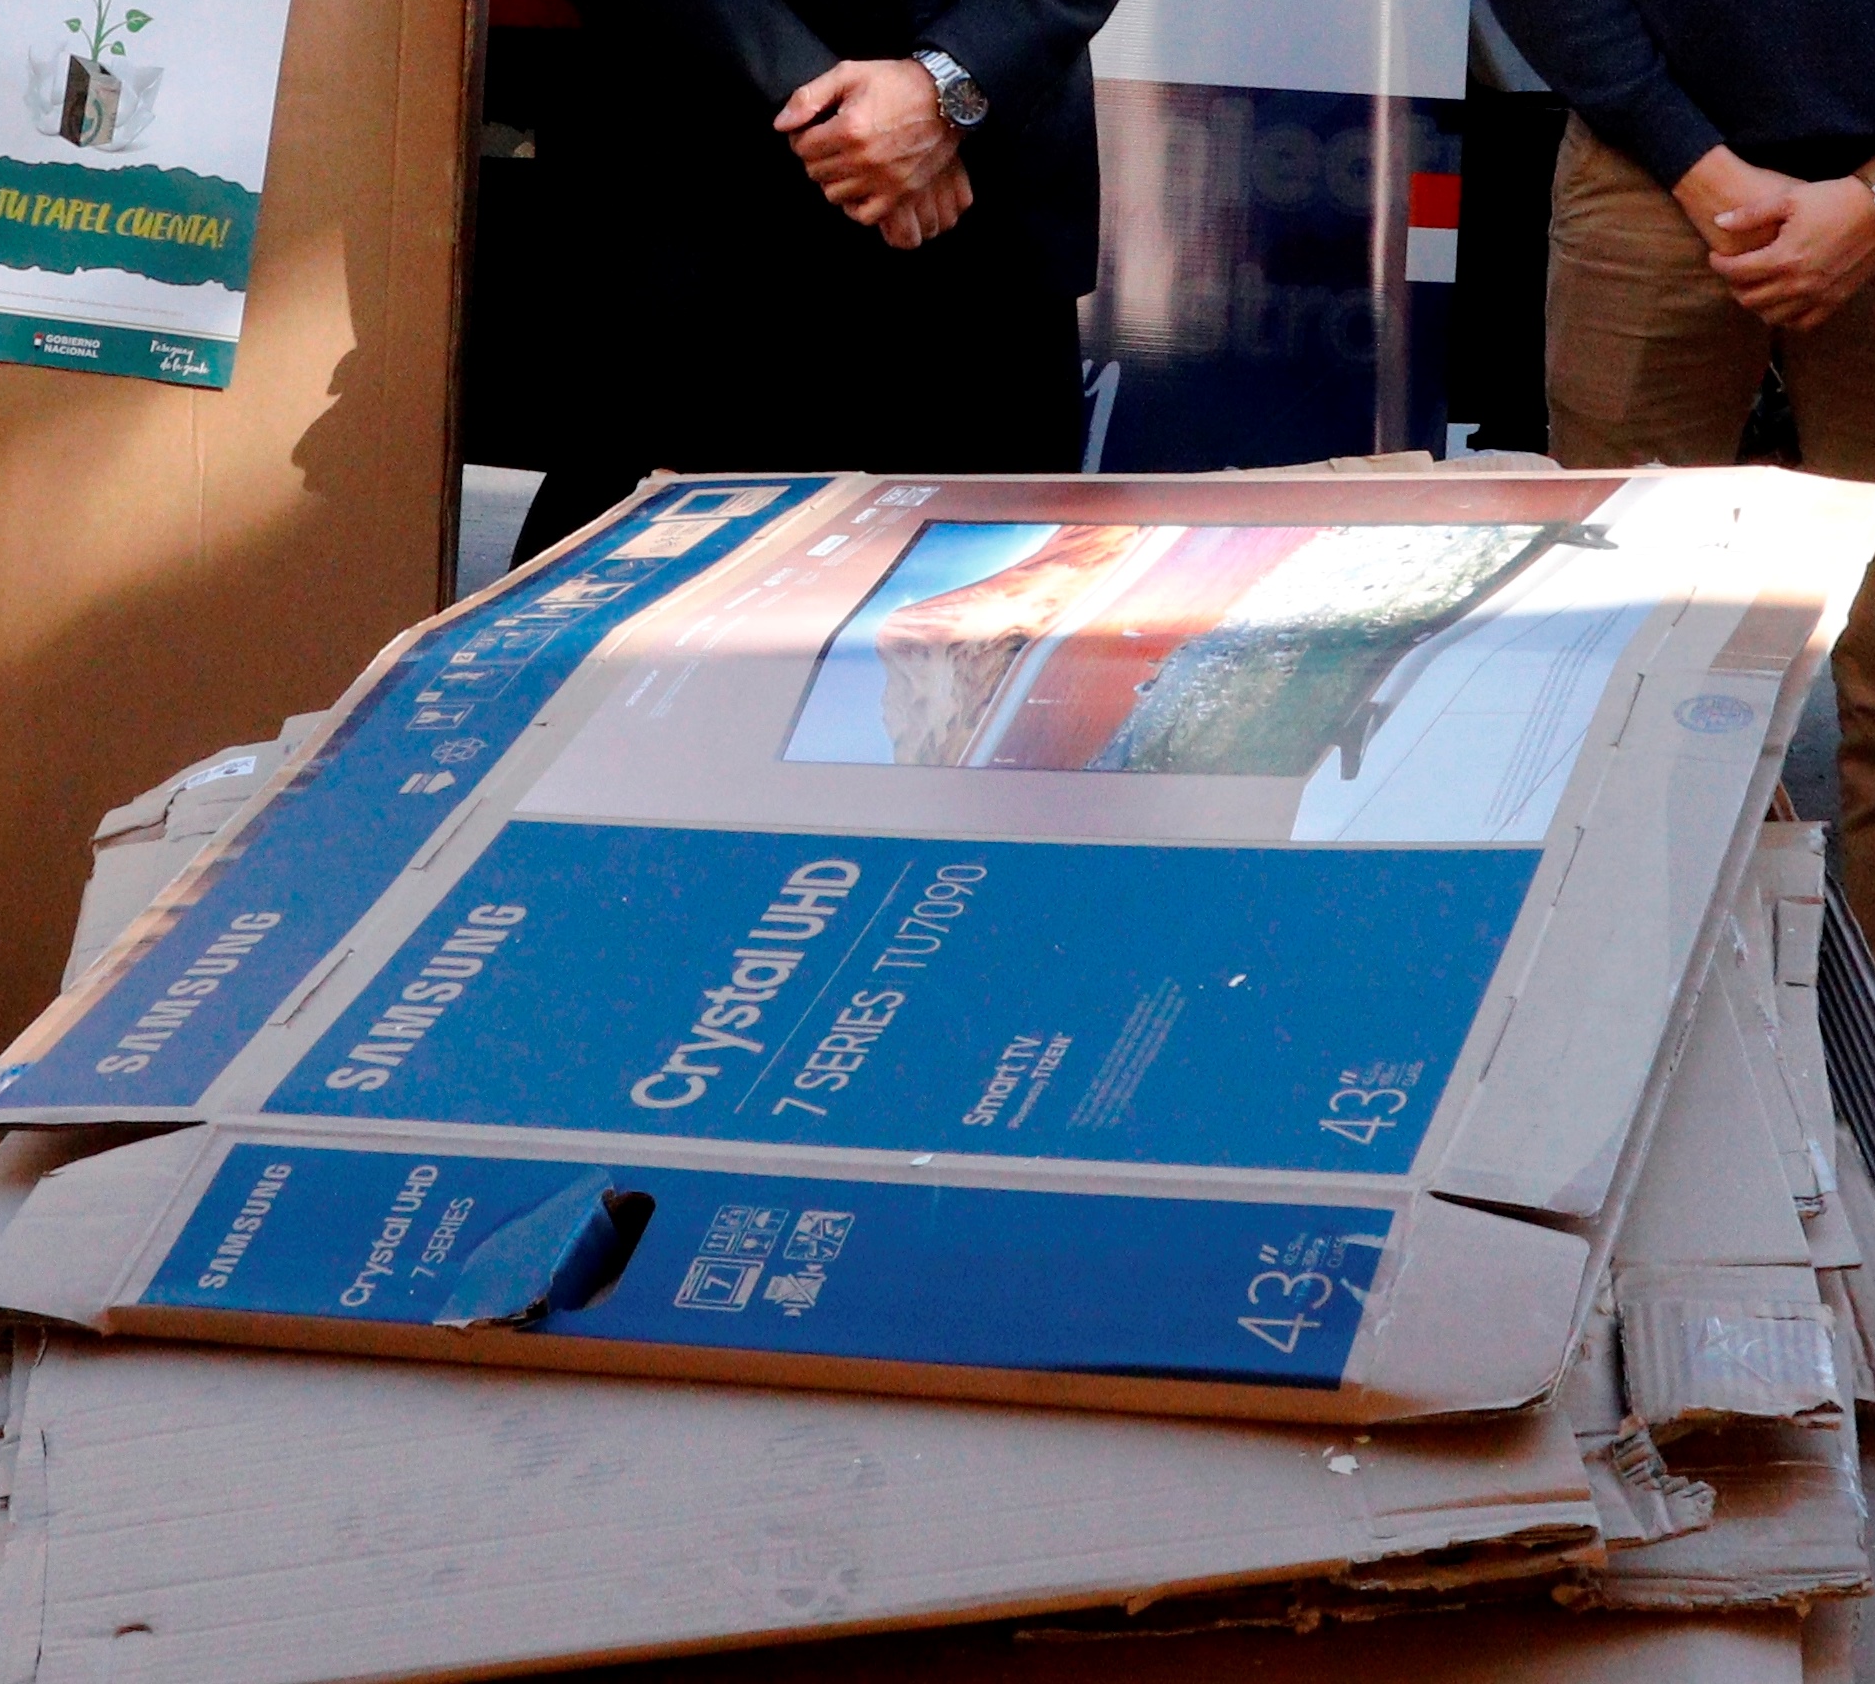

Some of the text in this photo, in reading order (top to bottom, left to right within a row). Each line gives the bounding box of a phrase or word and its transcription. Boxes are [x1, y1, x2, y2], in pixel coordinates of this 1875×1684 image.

[29, 192, 111, 235] PAPEL
[115, 206, 233, 250] CUENTA!
[44, 343, 100, 359] NACIONAL
[45, 333, 101, 349] GOBIERNO
[96, 911, 282, 1075] SAMSUNG
[326, 903, 527, 1092] SAMSUNG
[630, 858, 863, 1110] Crystal UHD
[771, 863, 989, 1119] 7 SERIES TU7090
[962, 1063, 1028, 1127] Smart
[1001, 1034, 1043, 1061] TV
[1318, 1069, 1409, 1146] 43"
[197, 1162, 294, 1291] SAMSUNG
[339, 1163, 439, 1308] Crystal UHD
[410, 1196, 477, 1282] 7 SERIES
[1236, 1243, 1334, 1355] 43"
